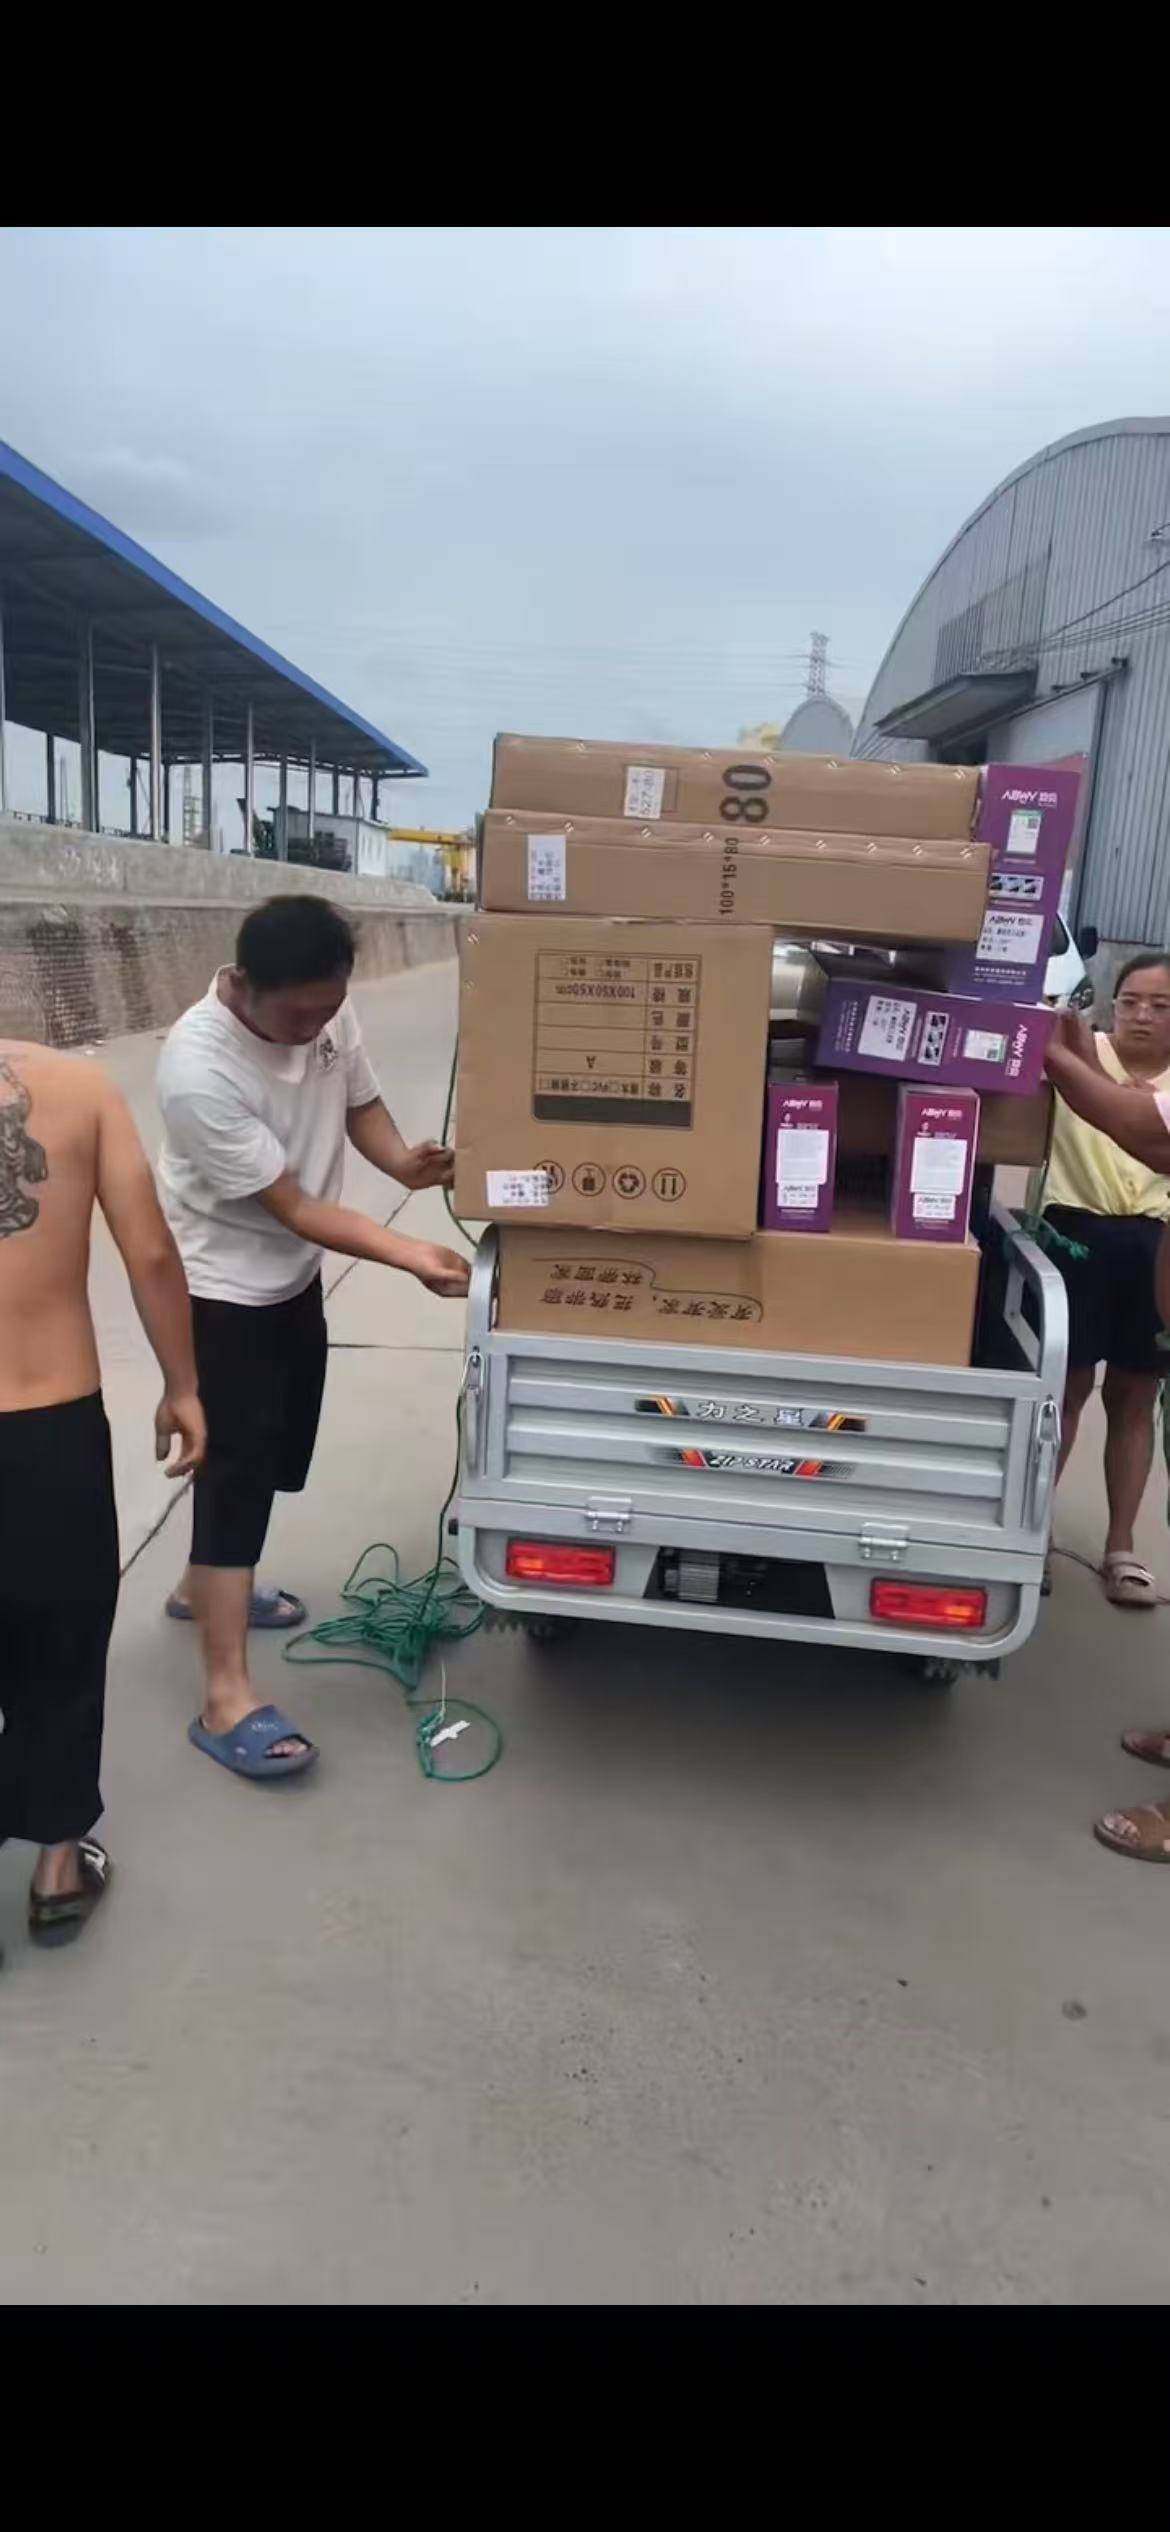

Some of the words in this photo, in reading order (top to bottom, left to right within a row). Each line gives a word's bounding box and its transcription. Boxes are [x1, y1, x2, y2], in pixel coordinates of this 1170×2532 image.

[719, 764, 772, 823] 80
[586, 1055, 596, 1069] A
[648, 1082, 686, 1098] 名称
[697, 1400, 804, 1425] 力之星
[710, 1455, 742, 1468] ZIP
[744, 1458, 795, 1473] STAR
